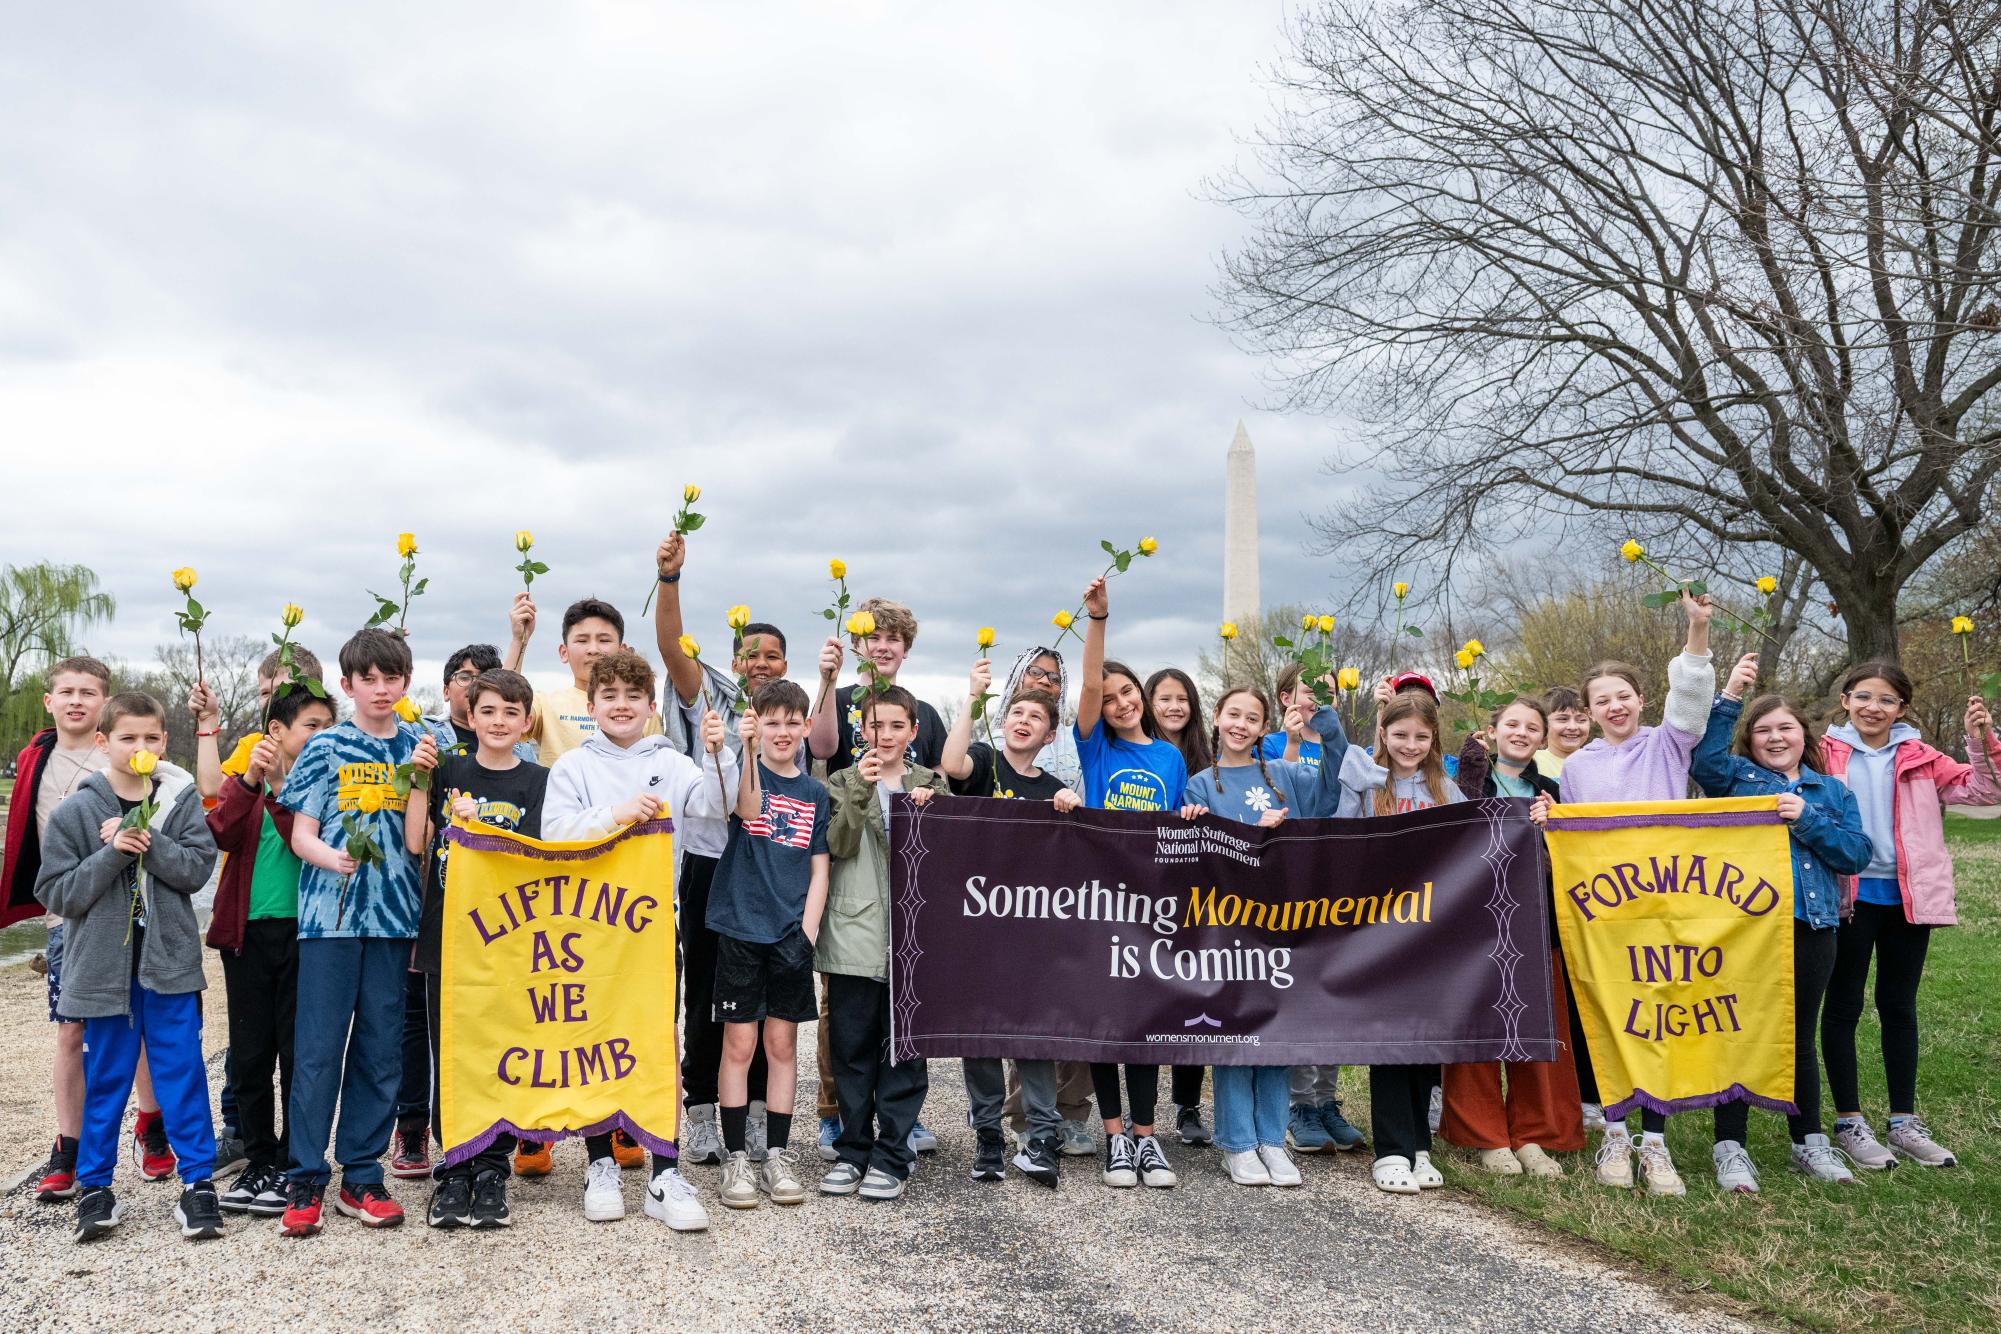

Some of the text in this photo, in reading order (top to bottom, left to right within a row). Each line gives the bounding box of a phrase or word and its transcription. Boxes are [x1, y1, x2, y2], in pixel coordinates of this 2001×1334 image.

[338, 762, 400, 787] MUSTA
[1119, 781, 1157, 801] MOUNT
[1111, 793, 1162, 811] HARMONY
[1155, 839, 1261, 867] National Monument
[1156, 825, 1251, 851] Women's Suffrage
[1154, 856, 1199, 864] FOUNDATION
[963, 875, 1433, 935] Something Monumental
[1567, 854, 1780, 922] FORWARD
[467, 875, 659, 947] LIFTING
[530, 929, 585, 974] AS
[1109, 935, 1294, 989] is Coming
[1626, 944, 1723, 983] INTO
[526, 982, 588, 1024] WE
[1623, 993, 1742, 1041] LIGHT
[1145, 1033, 1261, 1047] womensmonument.org
[497, 1037, 637, 1088] CLIMB
